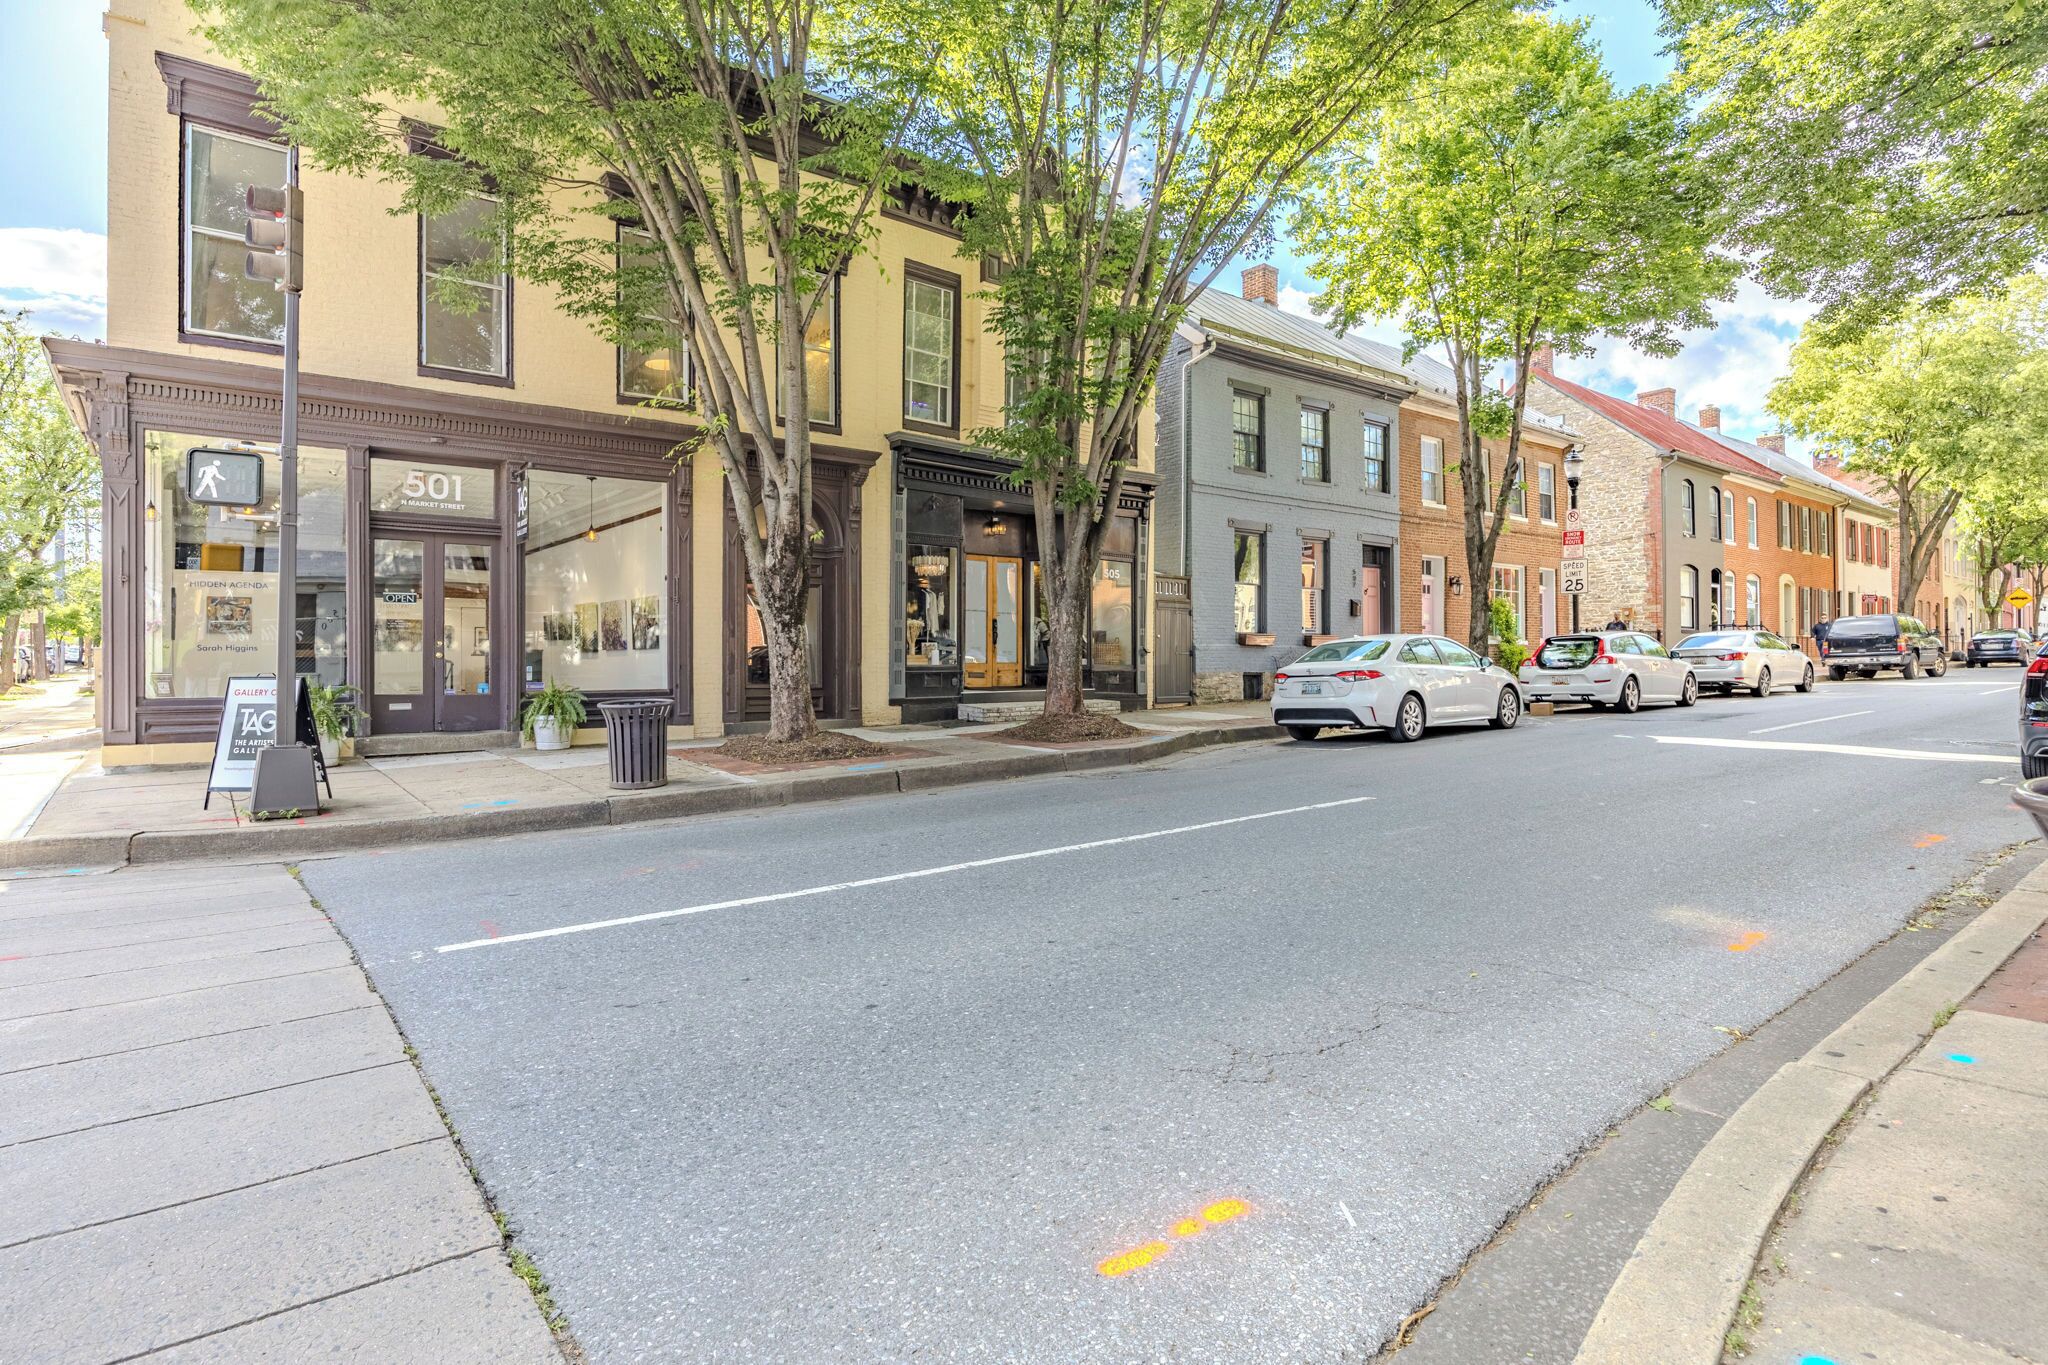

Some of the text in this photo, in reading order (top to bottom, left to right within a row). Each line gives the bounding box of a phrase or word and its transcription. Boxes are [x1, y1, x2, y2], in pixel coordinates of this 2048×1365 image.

[403, 470, 462, 501] 501
[440, 502, 466, 510] STREET
[517, 486, 528, 517] TAG
[1103, 568, 1120, 579] 505
[1565, 570, 1582, 578] LIMIT
[189, 580, 269, 589] HIDDEN AGENDA
[1565, 579, 1584, 592] 25
[385, 594, 415, 602] OPEN
[225, 644, 258, 653] Higgins
[234, 688, 269, 696] GALLERY
[240, 708, 276, 736] TAG
